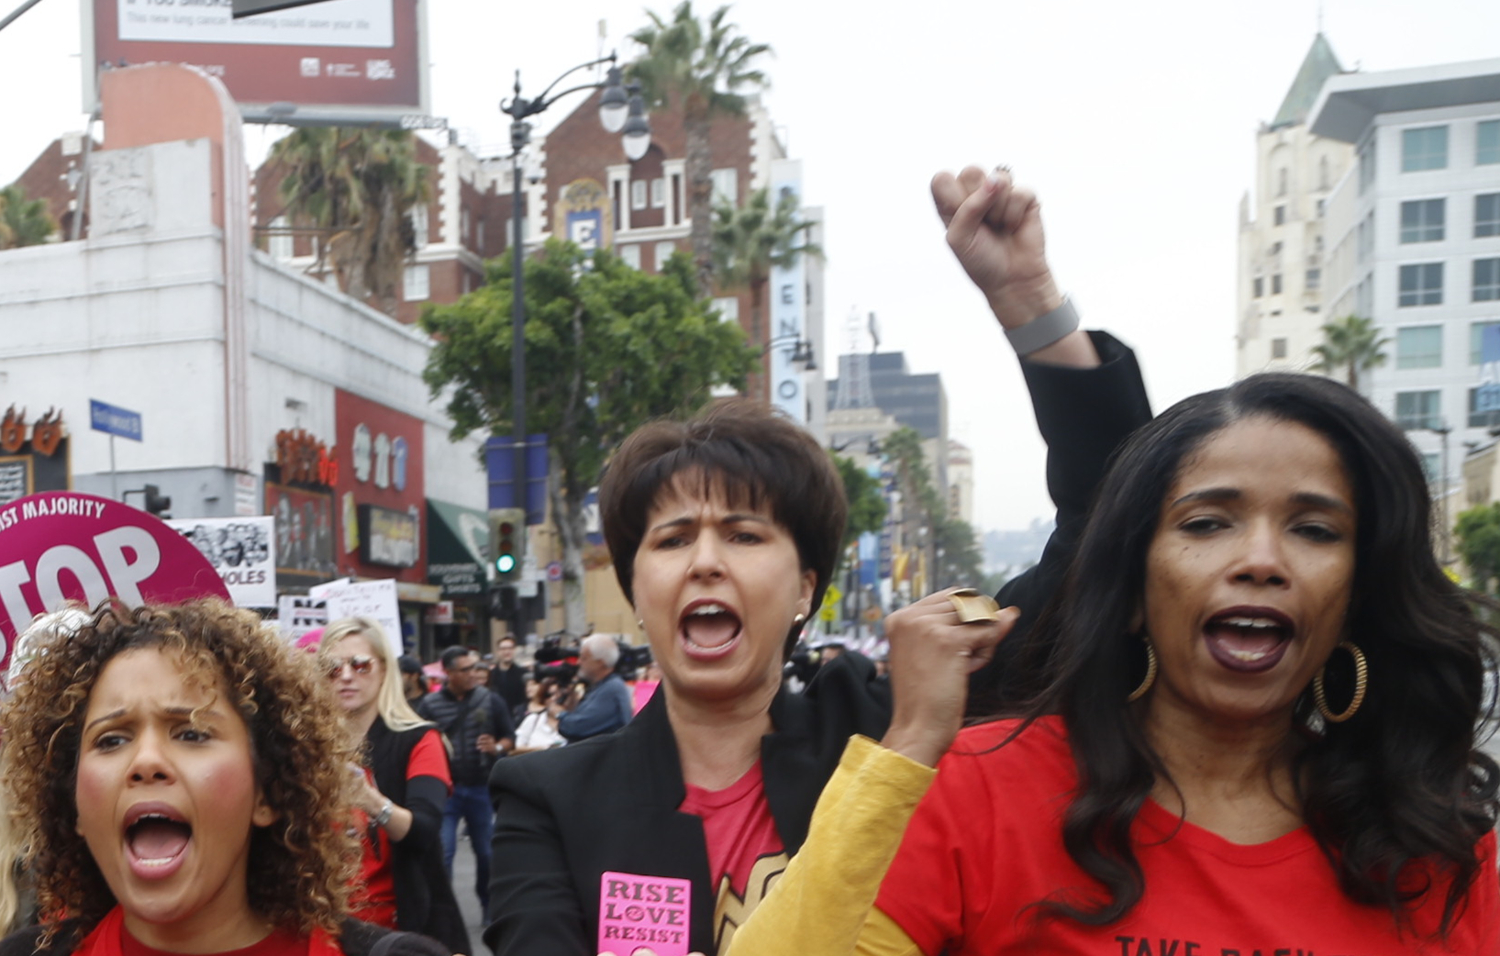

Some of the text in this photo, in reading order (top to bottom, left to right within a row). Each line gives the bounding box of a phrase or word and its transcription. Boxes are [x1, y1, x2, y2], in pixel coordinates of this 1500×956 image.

[23, 497, 106, 519] MAJORITY
[607, 880, 685, 905] RISE
[605, 902, 684, 926] LOVE
[604, 925, 684, 944] RESIST
